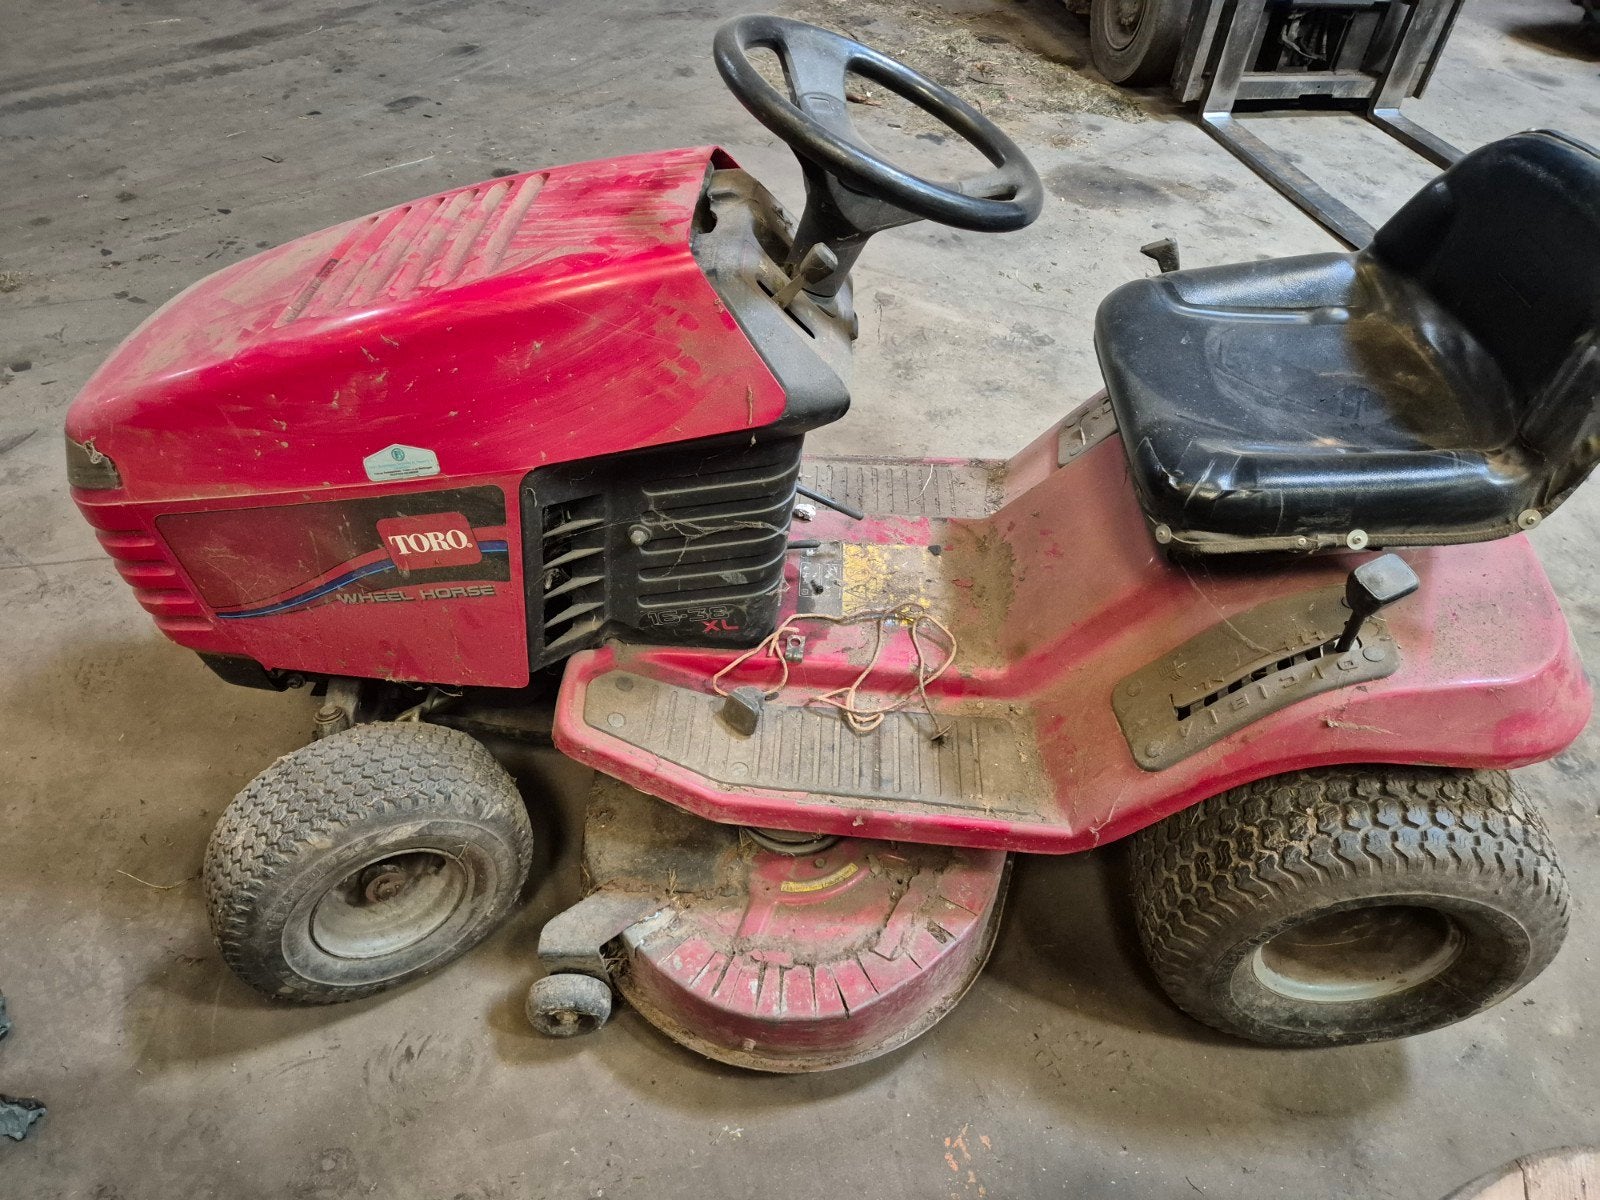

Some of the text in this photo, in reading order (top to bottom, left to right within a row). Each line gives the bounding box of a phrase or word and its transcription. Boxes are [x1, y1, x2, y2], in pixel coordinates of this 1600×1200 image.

[335, 584, 496, 605] WHEEL HORSE
[703, 619, 739, 633] XL
